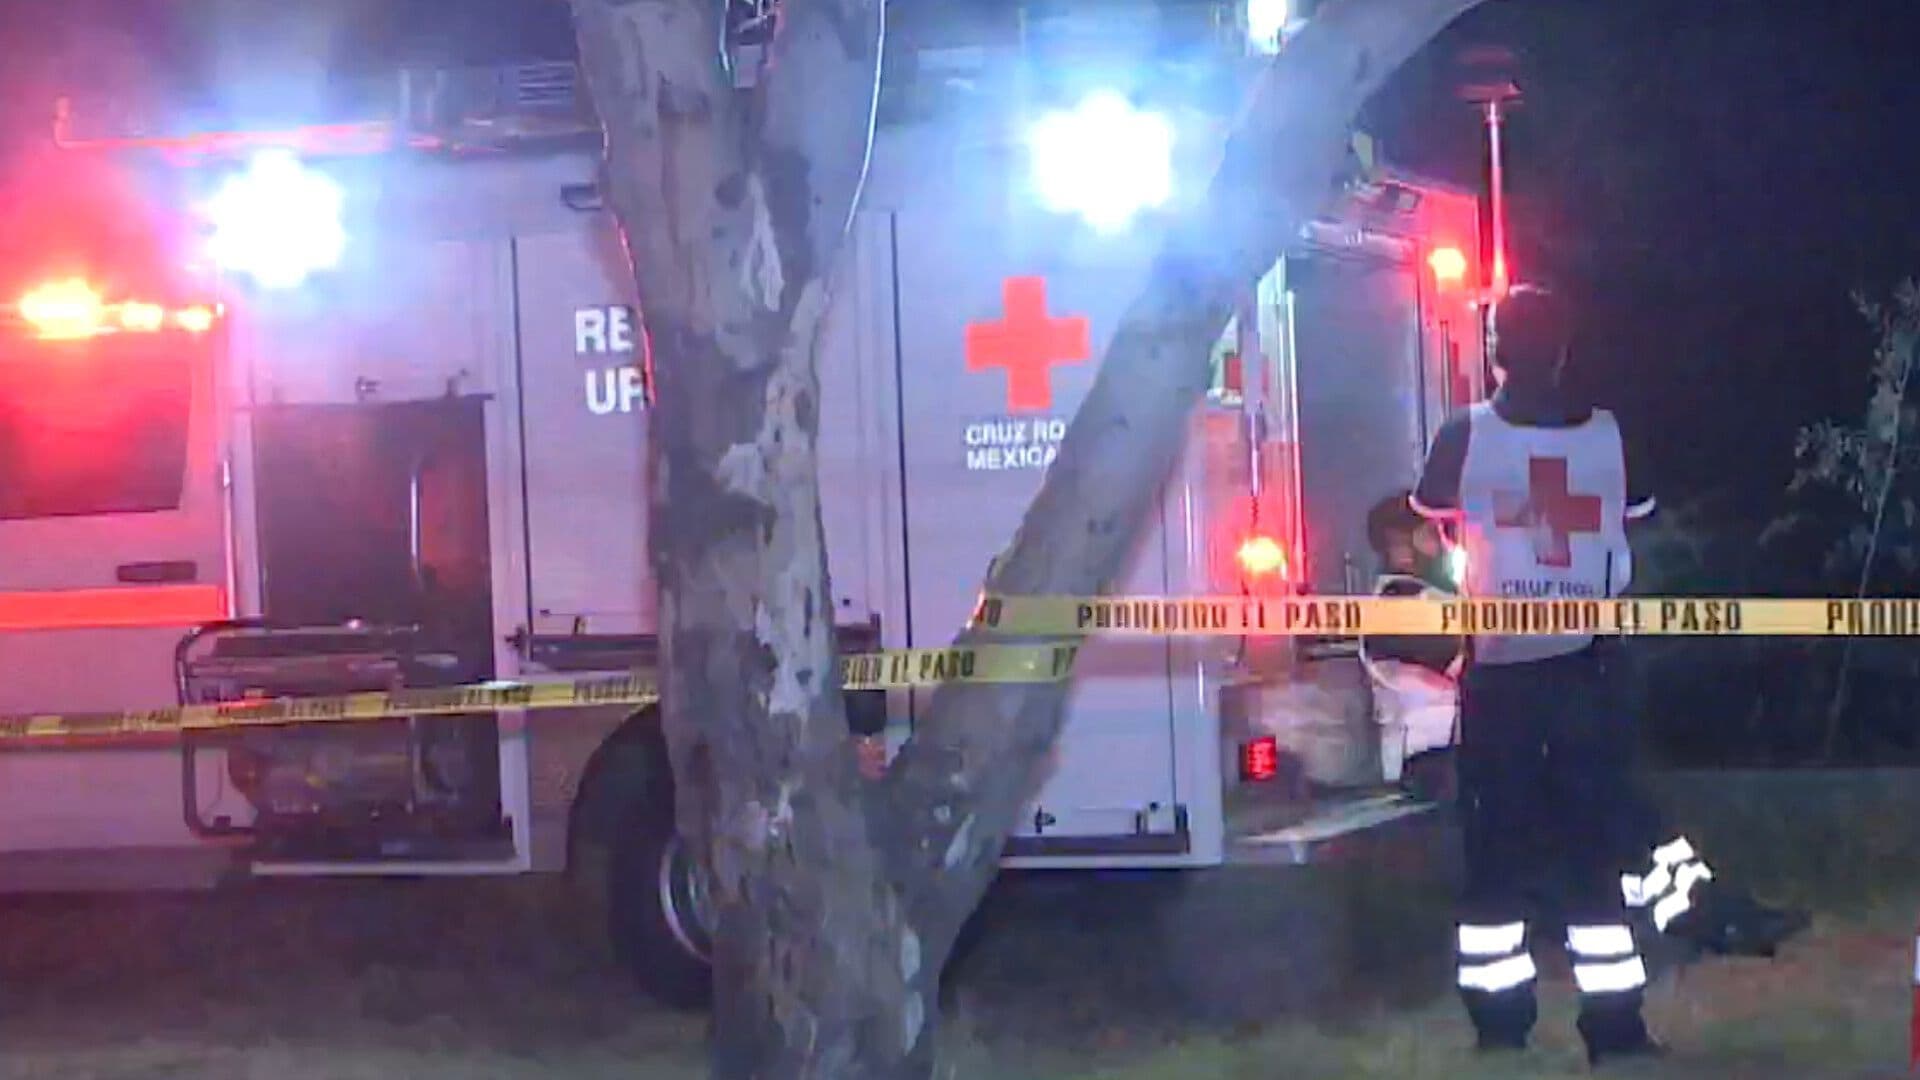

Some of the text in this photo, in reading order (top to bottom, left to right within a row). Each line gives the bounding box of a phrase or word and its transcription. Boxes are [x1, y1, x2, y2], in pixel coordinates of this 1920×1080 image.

[575, 305, 633, 353] RE
[966, 421, 1026, 446] CRUZ
[1077, 602, 1226, 630] PROHIBIDO
[1285, 602, 1362, 630] PASO
[1441, 602, 1600, 632] PROHIBIDO
[1614, 602, 1640, 631] EL
[1660, 601, 1741, 632] PASO
[918, 650, 976, 682] PASO
